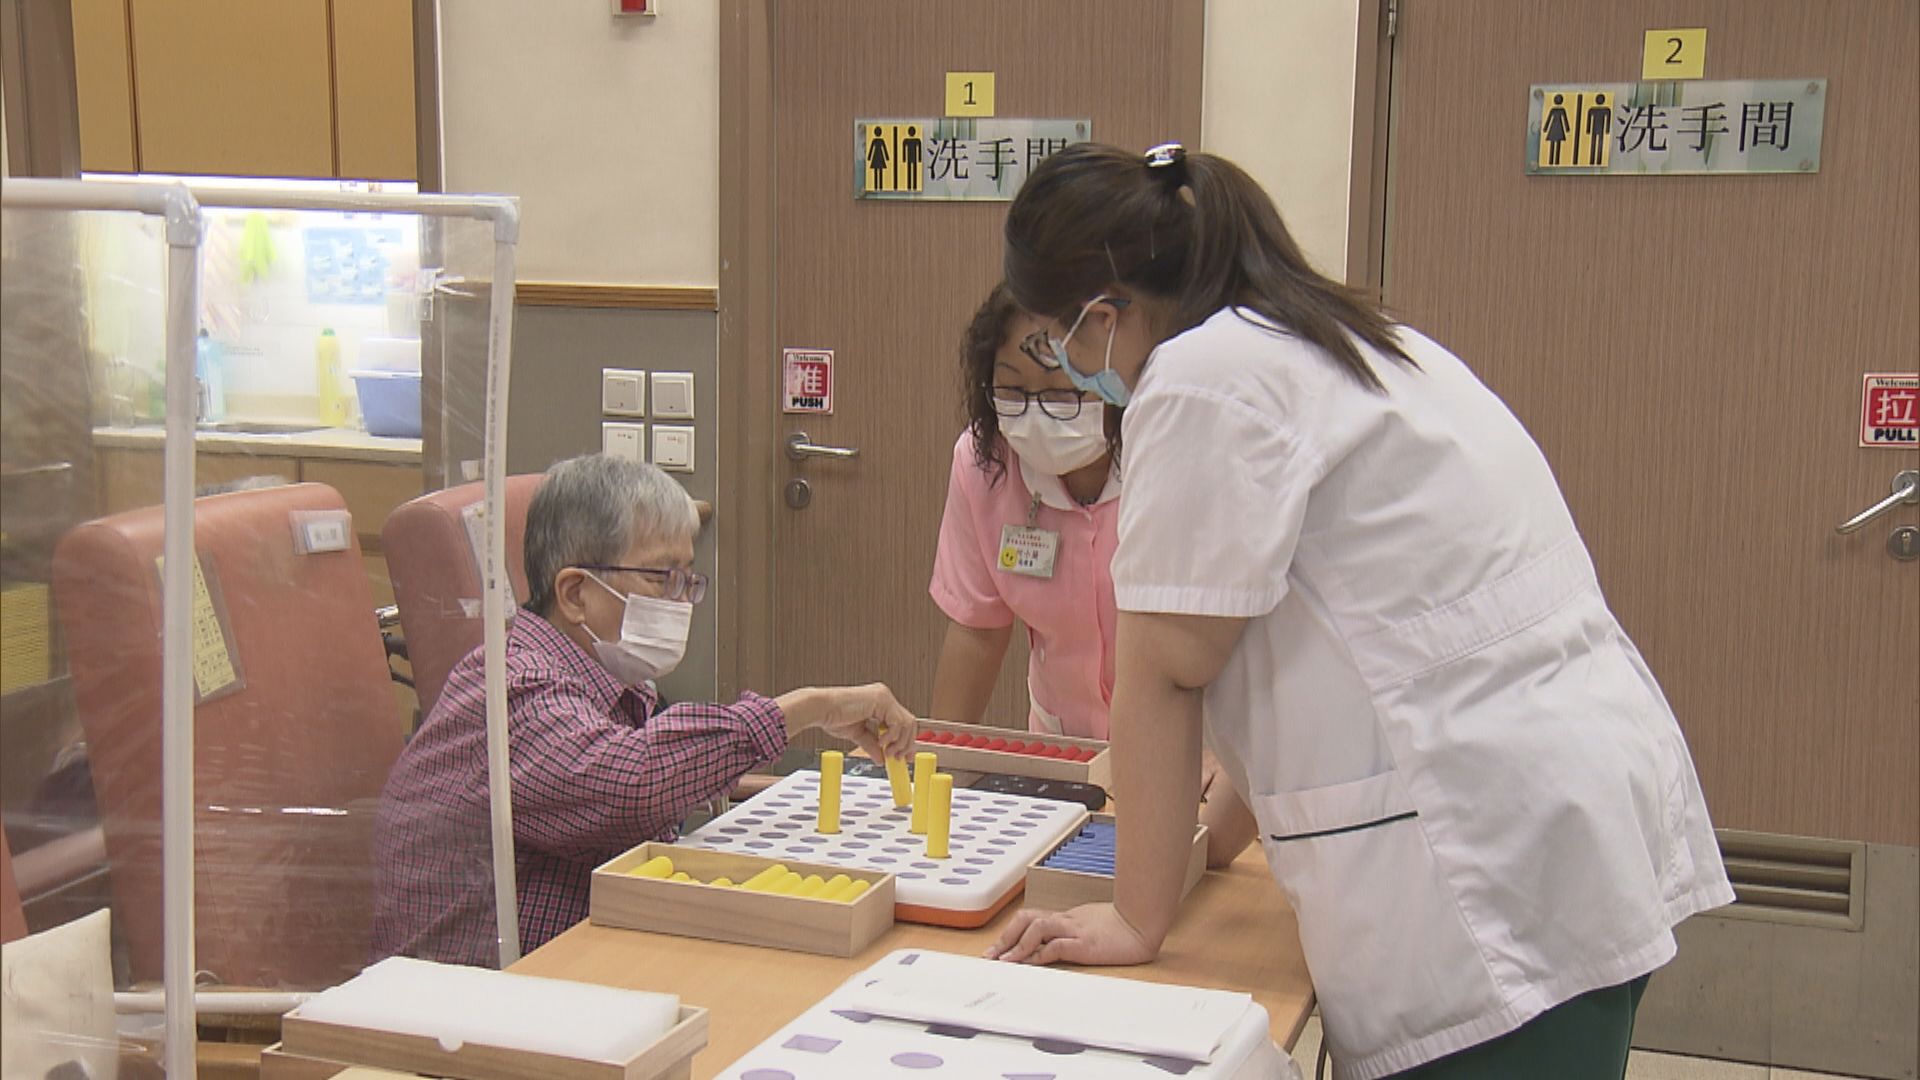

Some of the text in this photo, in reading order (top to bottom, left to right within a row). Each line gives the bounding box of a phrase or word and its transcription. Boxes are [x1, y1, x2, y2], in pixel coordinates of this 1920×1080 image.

[1665, 38, 1683, 64] 2
[963, 81, 977, 105] 1
[1616, 102, 1794, 153] 洗手間
[1875, 378, 1918, 386] Welcome
[792, 397, 824, 408] PUSH
[1876, 390, 1916, 425] 拉
[1874, 428, 1916, 441] PULL
